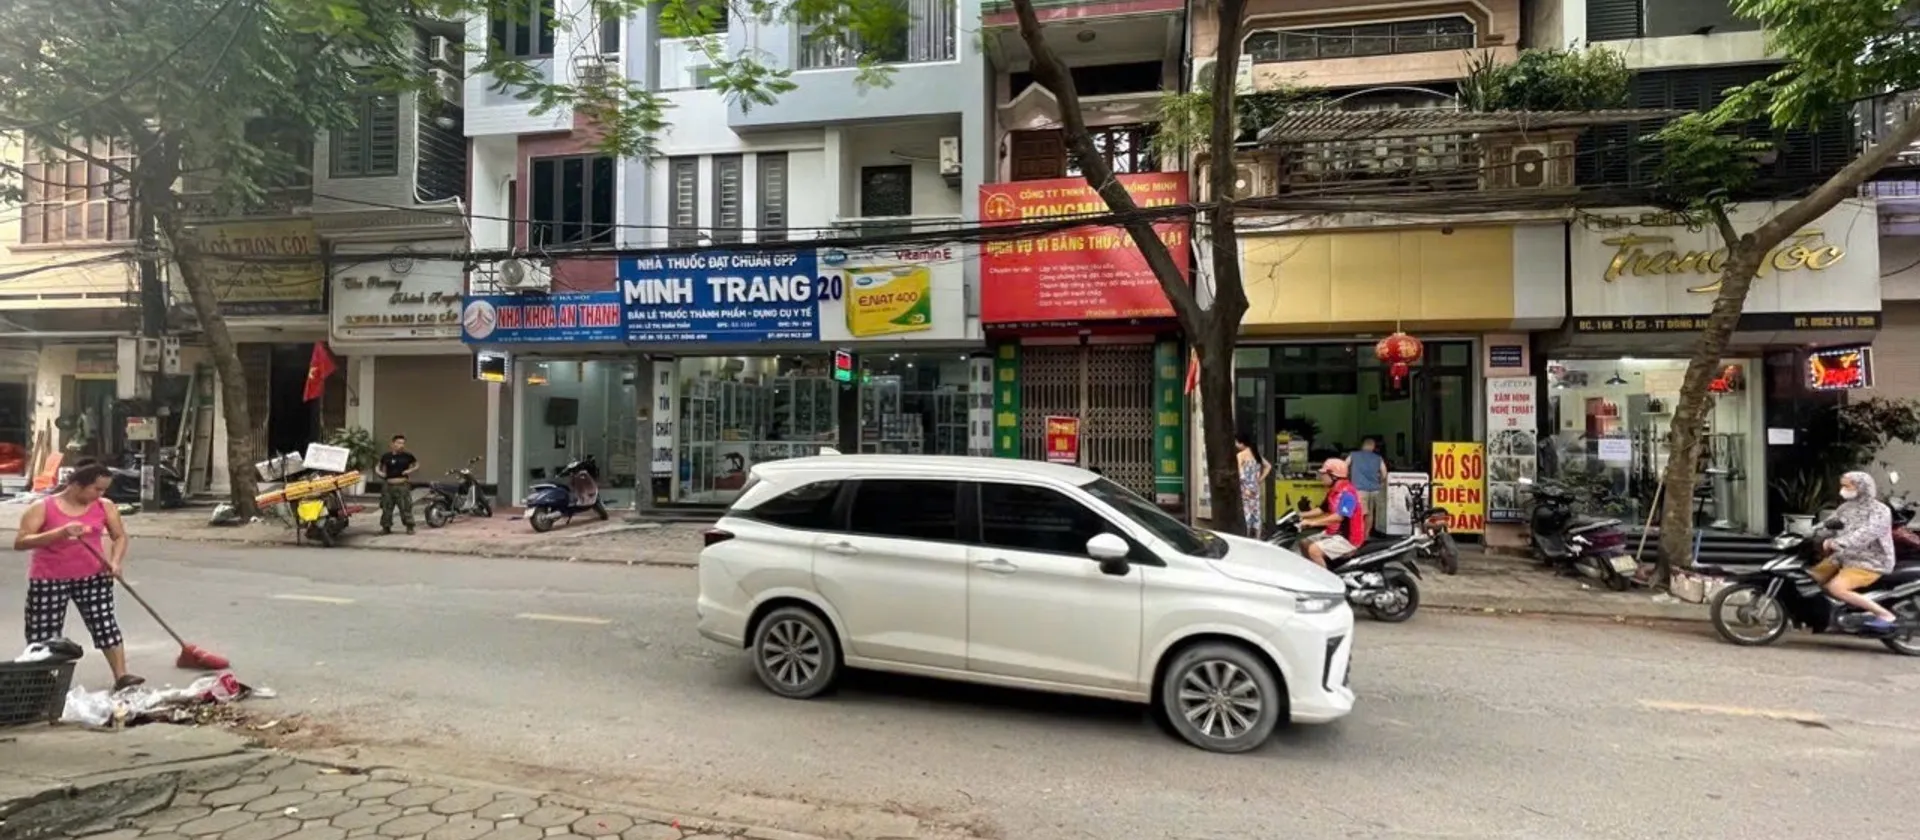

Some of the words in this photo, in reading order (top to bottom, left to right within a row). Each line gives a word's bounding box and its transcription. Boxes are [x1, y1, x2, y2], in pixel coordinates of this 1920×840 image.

[1153, 182, 1177, 191] MINH
[638, 255, 663, 270] NHÀ
[667, 253, 705, 269] THUỐC
[708, 255, 729, 271] ĐẠT
[896, 251, 939, 260] Vitamin
[943, 248, 952, 260] E
[624, 277, 694, 305] MINH
[707, 275, 812, 304] TRANG
[818, 275, 843, 301] 20
[858, 293, 894, 307] ENAT
[896, 291, 918, 302] 400
[417, 313, 437, 323] CAO
[438, 308, 459, 323] CẤP
[524, 304, 557, 329] KHOA
[559, 304, 577, 328] AN
[660, 308, 688, 319] THUỐC
[690, 308, 720, 319] THÀNH
[753, 308, 778, 319] DỤNG
[779, 308, 792, 319] CỤ
[793, 308, 801, 317] Y
[801, 305, 813, 317] TẾ
[1434, 444, 1457, 481] XỔ
[1460, 444, 1483, 481] SỐ
[1436, 485, 1481, 508] ĐIỆN
